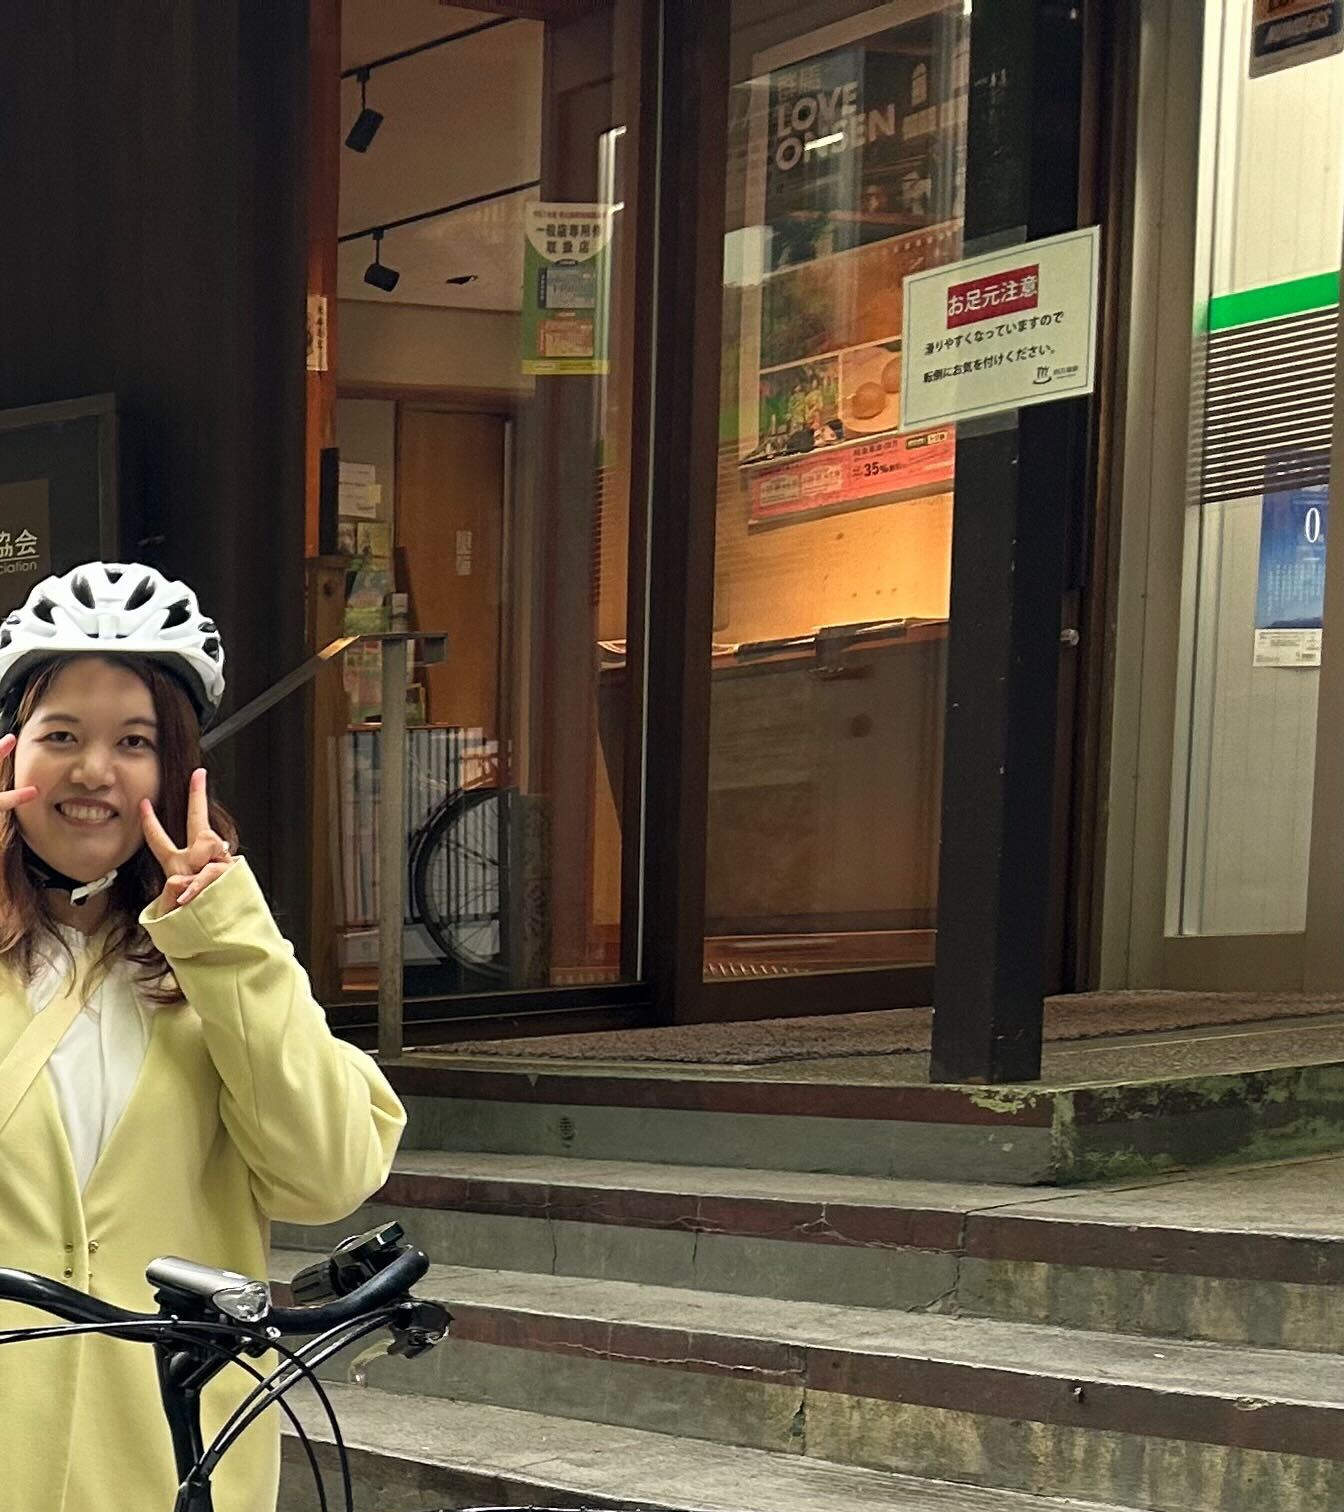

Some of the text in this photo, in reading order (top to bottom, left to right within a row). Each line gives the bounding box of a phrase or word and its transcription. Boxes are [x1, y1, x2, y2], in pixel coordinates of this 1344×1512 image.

[777, 81, 859, 138] LOVE
[947, 274, 1038, 317] お足元注意
